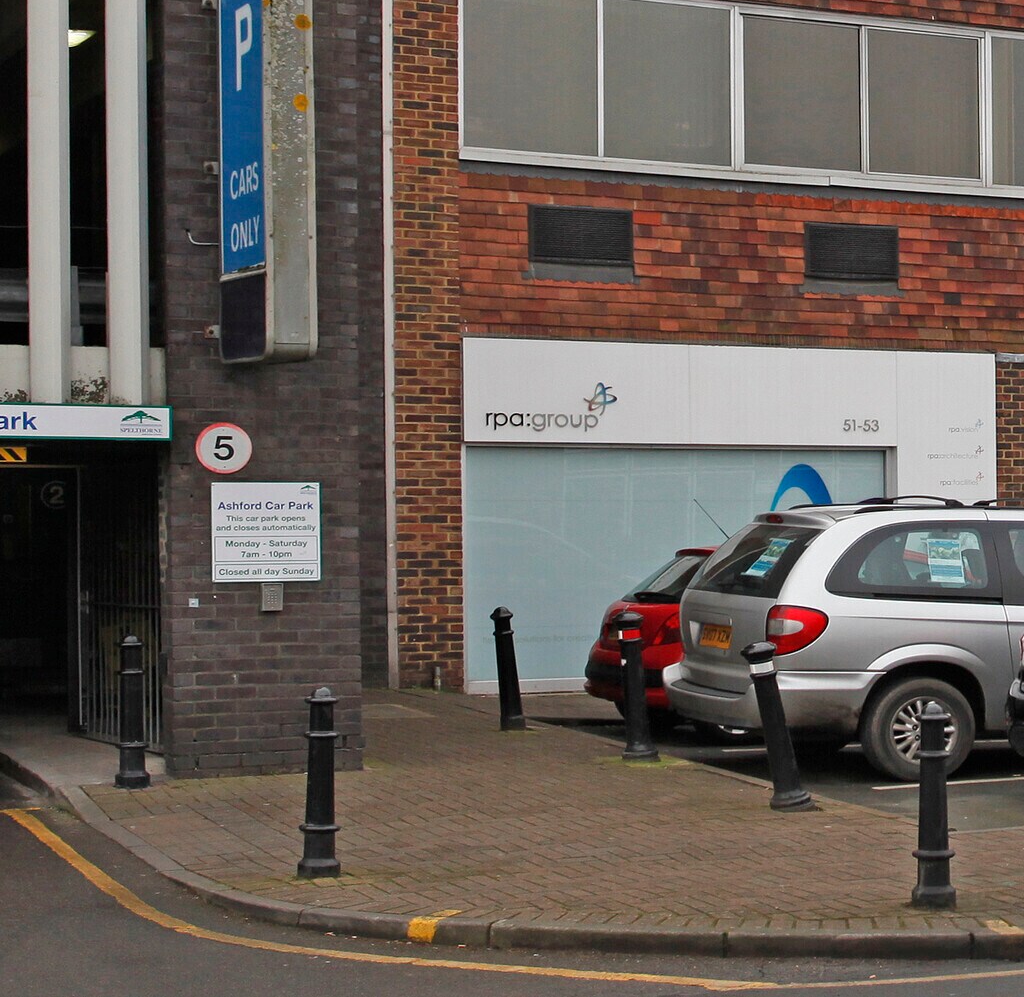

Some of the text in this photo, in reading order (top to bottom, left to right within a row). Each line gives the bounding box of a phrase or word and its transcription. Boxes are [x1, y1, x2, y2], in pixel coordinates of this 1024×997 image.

[235, 3, 252, 92] P
[230, 161, 259, 200] CARS
[230, 214, 260, 252] ONLY
[485, 411, 599, 432] rpa:group
[843, 418, 879, 432] 51-53
[213, 435, 235, 461] 5
[217, 501, 314, 510] Ashford Car Park
[260, 515, 279, 523] park
[262, 524, 316, 532] automatically
[225, 540, 261, 548] Monday
[269, 540, 308, 548] Saturday
[240, 550, 260, 558] 7am
[269, 550, 293, 559] 10pm
[218, 567, 315, 576] Closed all day Sunday
